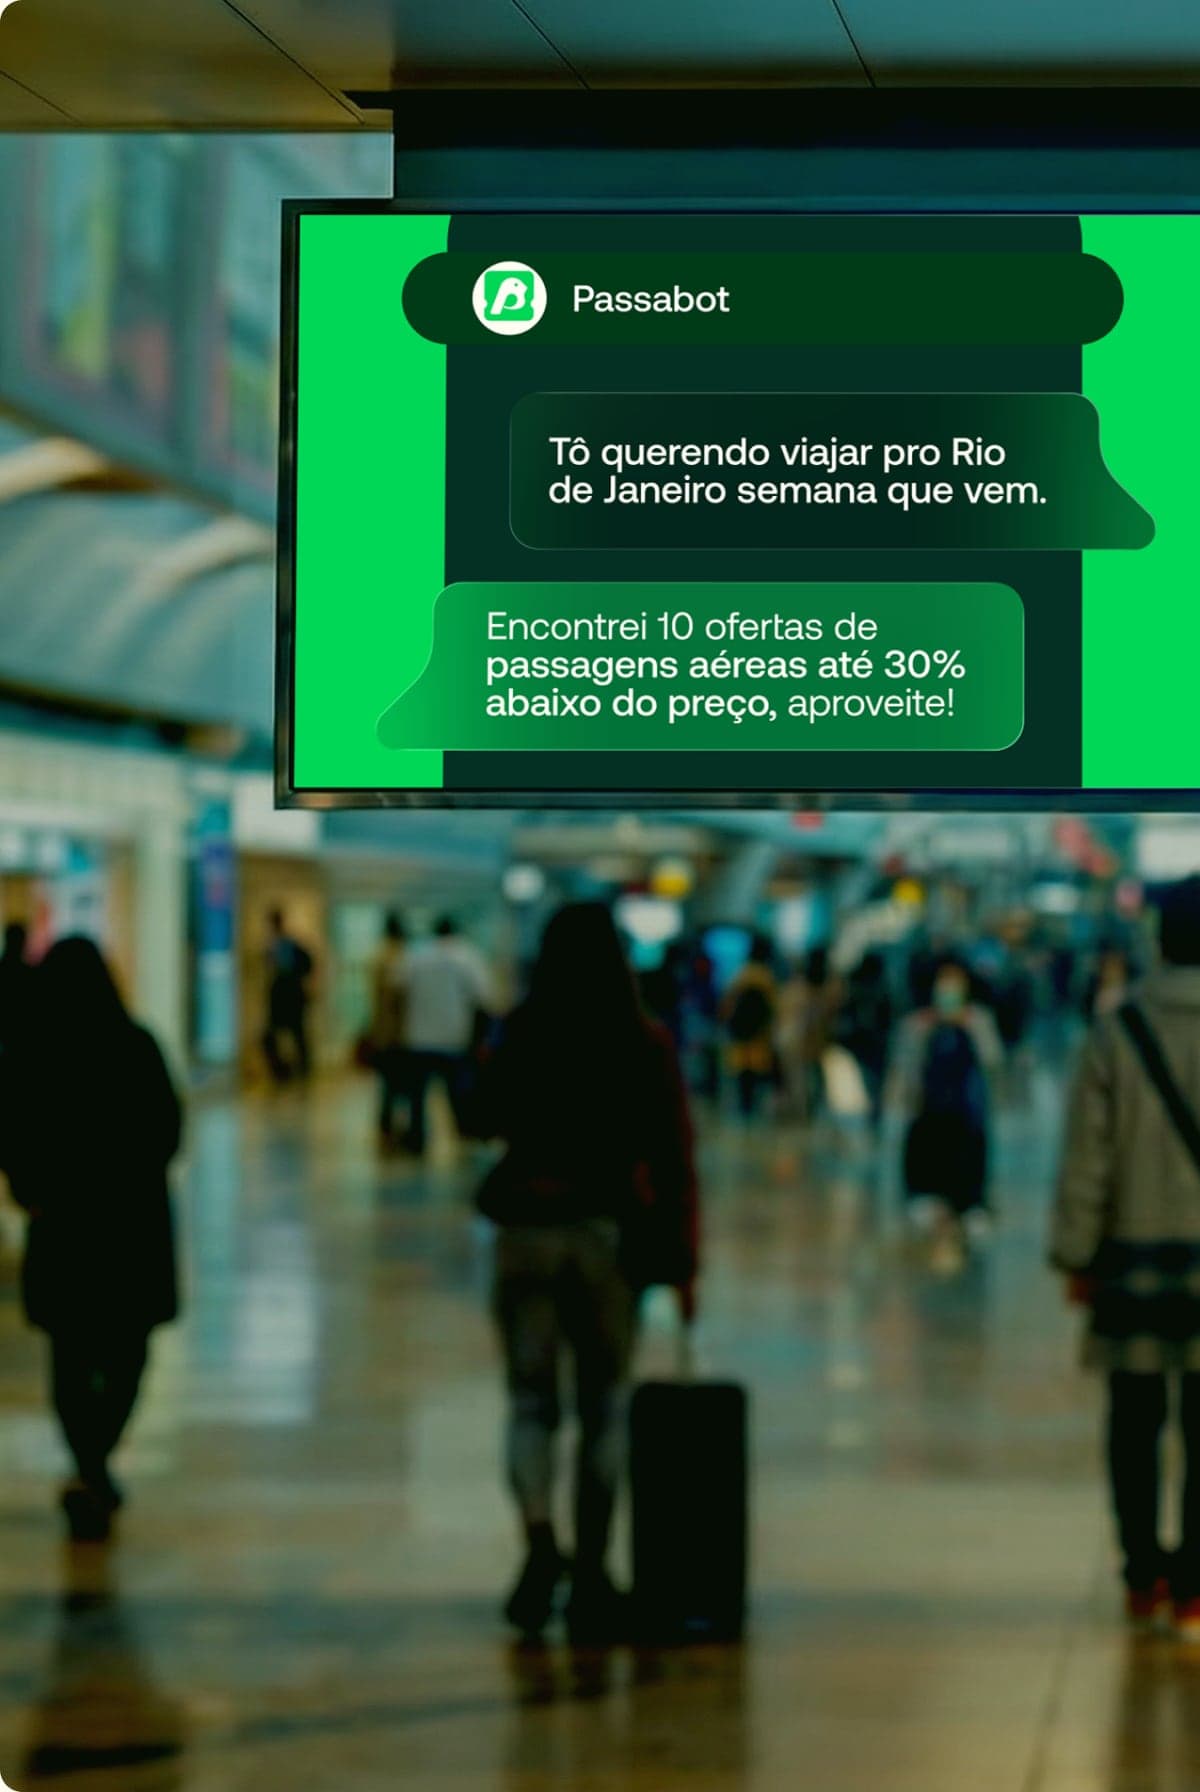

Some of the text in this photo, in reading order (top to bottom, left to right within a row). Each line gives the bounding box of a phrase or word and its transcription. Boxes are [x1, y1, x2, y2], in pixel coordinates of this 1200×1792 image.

[574, 285, 729, 312] Passabot
[549, 437, 1005, 473] Tô querendo viajar pro Rio
[549, 475, 1046, 511] de Janeiro semana que vem.
[488, 612, 877, 640] Encontrei 10 ofertas de
[488, 650, 965, 685] passagens aéreas até 30%
[487, 688, 953, 723] abaixo do preço, aproveite!
